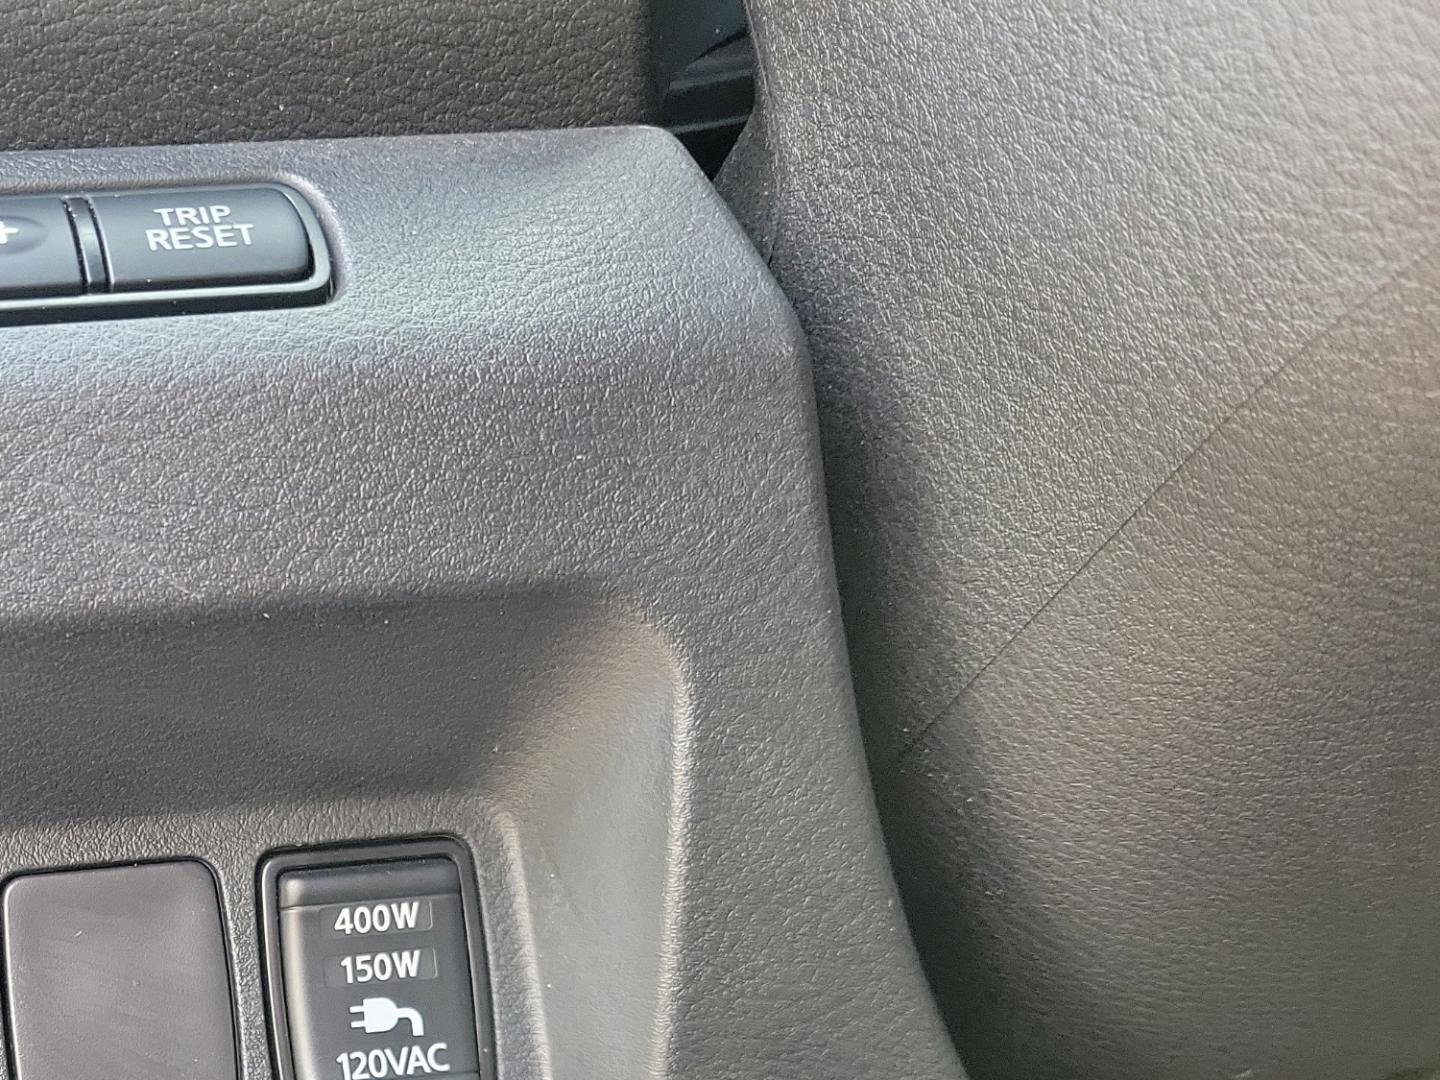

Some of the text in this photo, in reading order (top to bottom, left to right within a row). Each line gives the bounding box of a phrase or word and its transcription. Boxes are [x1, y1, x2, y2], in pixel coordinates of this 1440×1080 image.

[153, 205, 231, 226] TRIP
[145, 223, 254, 251] RESET
[334, 901, 420, 935] 400W
[340, 949, 421, 984] 150W
